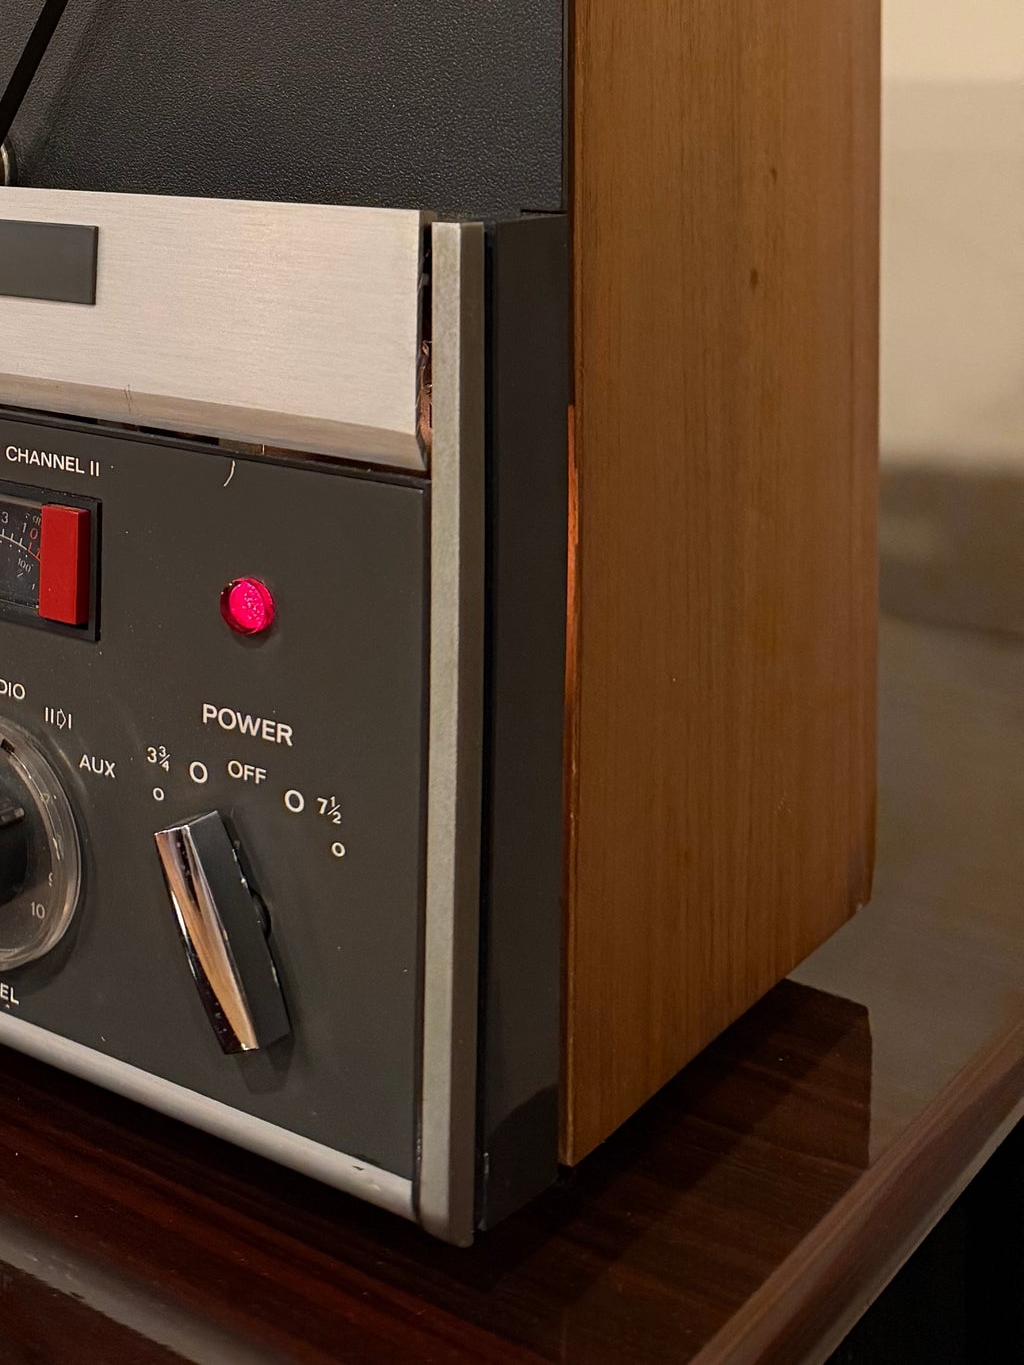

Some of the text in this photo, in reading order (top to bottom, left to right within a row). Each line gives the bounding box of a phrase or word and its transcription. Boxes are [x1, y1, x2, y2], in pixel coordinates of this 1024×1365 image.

[5, 445, 85, 474] CHANNEL
[0, 511, 10, 524] 3
[202, 703, 293, 747] POWER
[79, 753, 116, 779] AUX
[227, 760, 267, 784] OFF
[30, 901, 45, 919] 10
